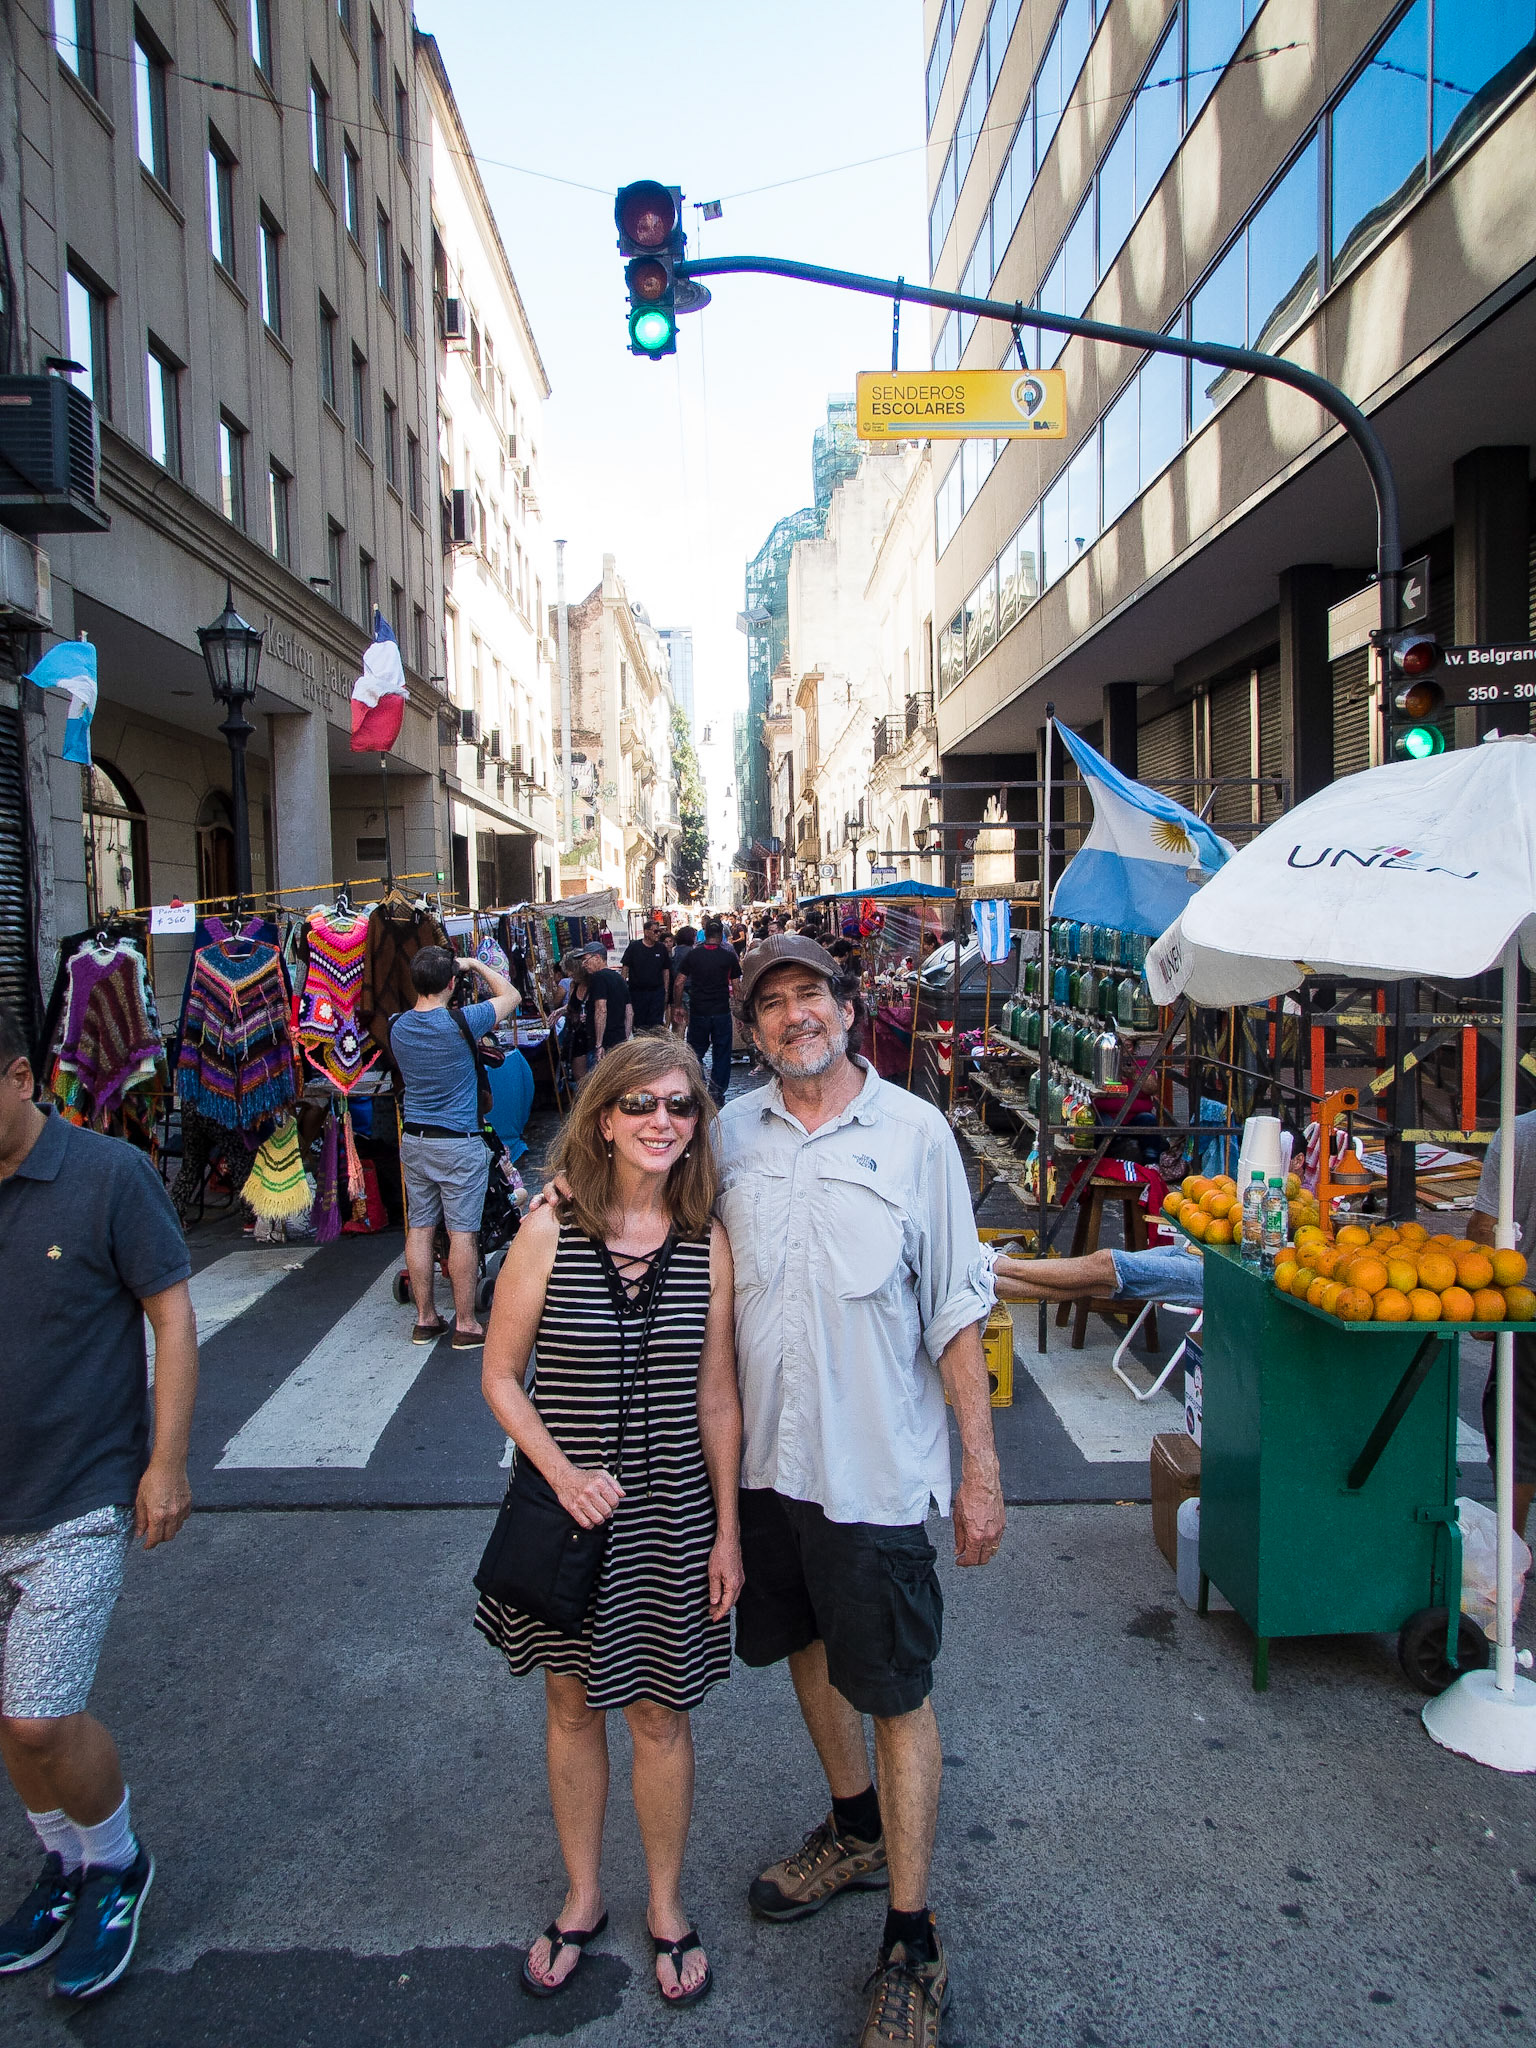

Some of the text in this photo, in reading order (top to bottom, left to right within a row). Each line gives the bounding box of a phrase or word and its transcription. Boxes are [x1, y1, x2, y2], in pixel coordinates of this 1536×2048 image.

[872, 386, 965, 400] SENDEROS
[872, 402, 965, 415] ESCOLARES
[264, 613, 315, 680] Kenton
[1468, 648, 1536, 666] Belgran
[1468, 685, 1499, 701] 350
[1513, 683, 1536, 698] 30
[1432, 1015, 1488, 1024] ROWING
